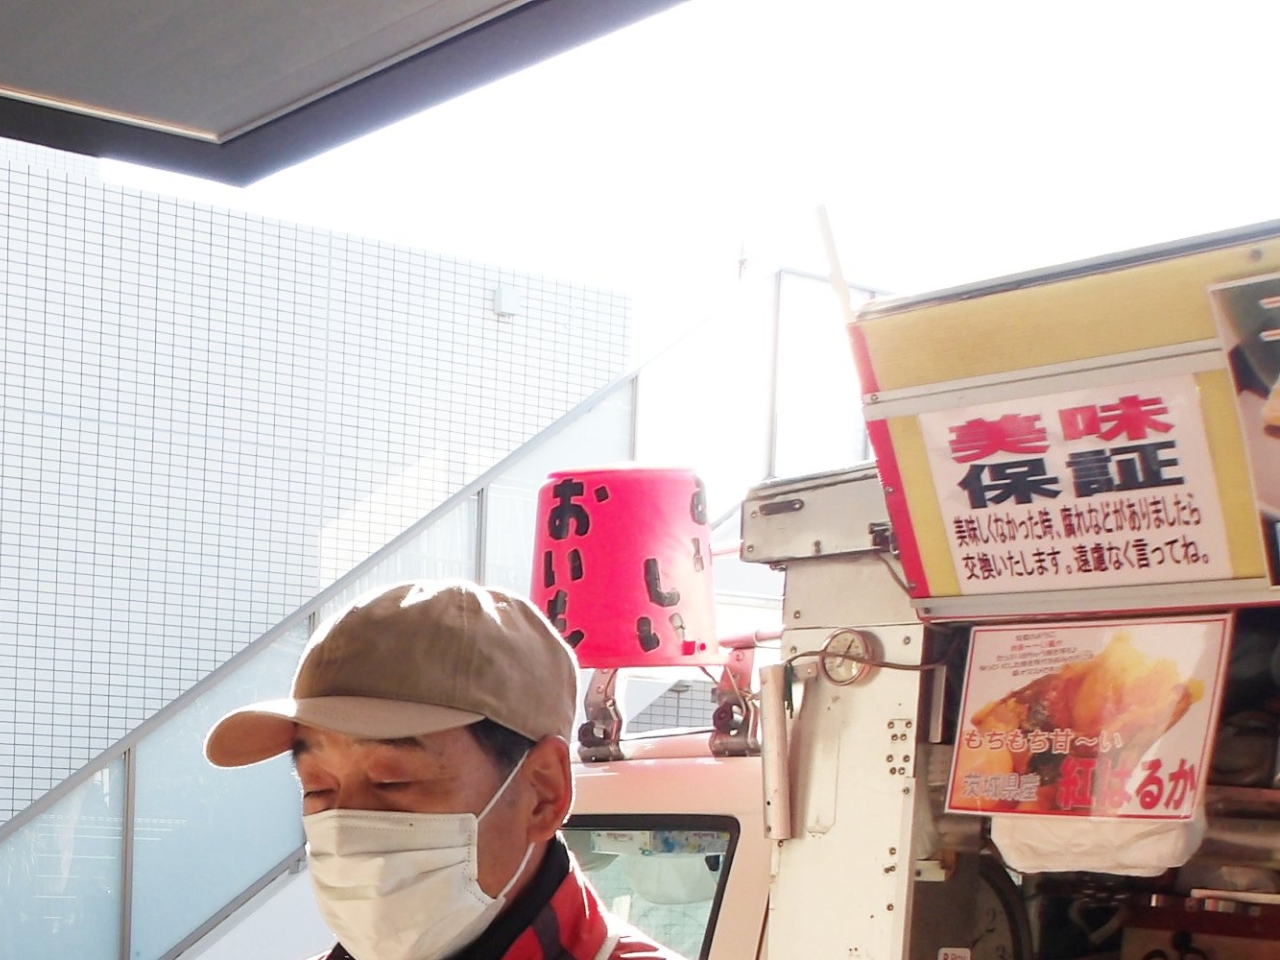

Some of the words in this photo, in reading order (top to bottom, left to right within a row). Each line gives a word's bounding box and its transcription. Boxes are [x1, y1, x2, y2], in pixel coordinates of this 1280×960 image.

[948, 395, 1174, 464] 美味
[957, 440, 1185, 508] 保証
[962, 772, 1041, 801] 茨城県産
[1058, 757, 1197, 812] 紅はるか
